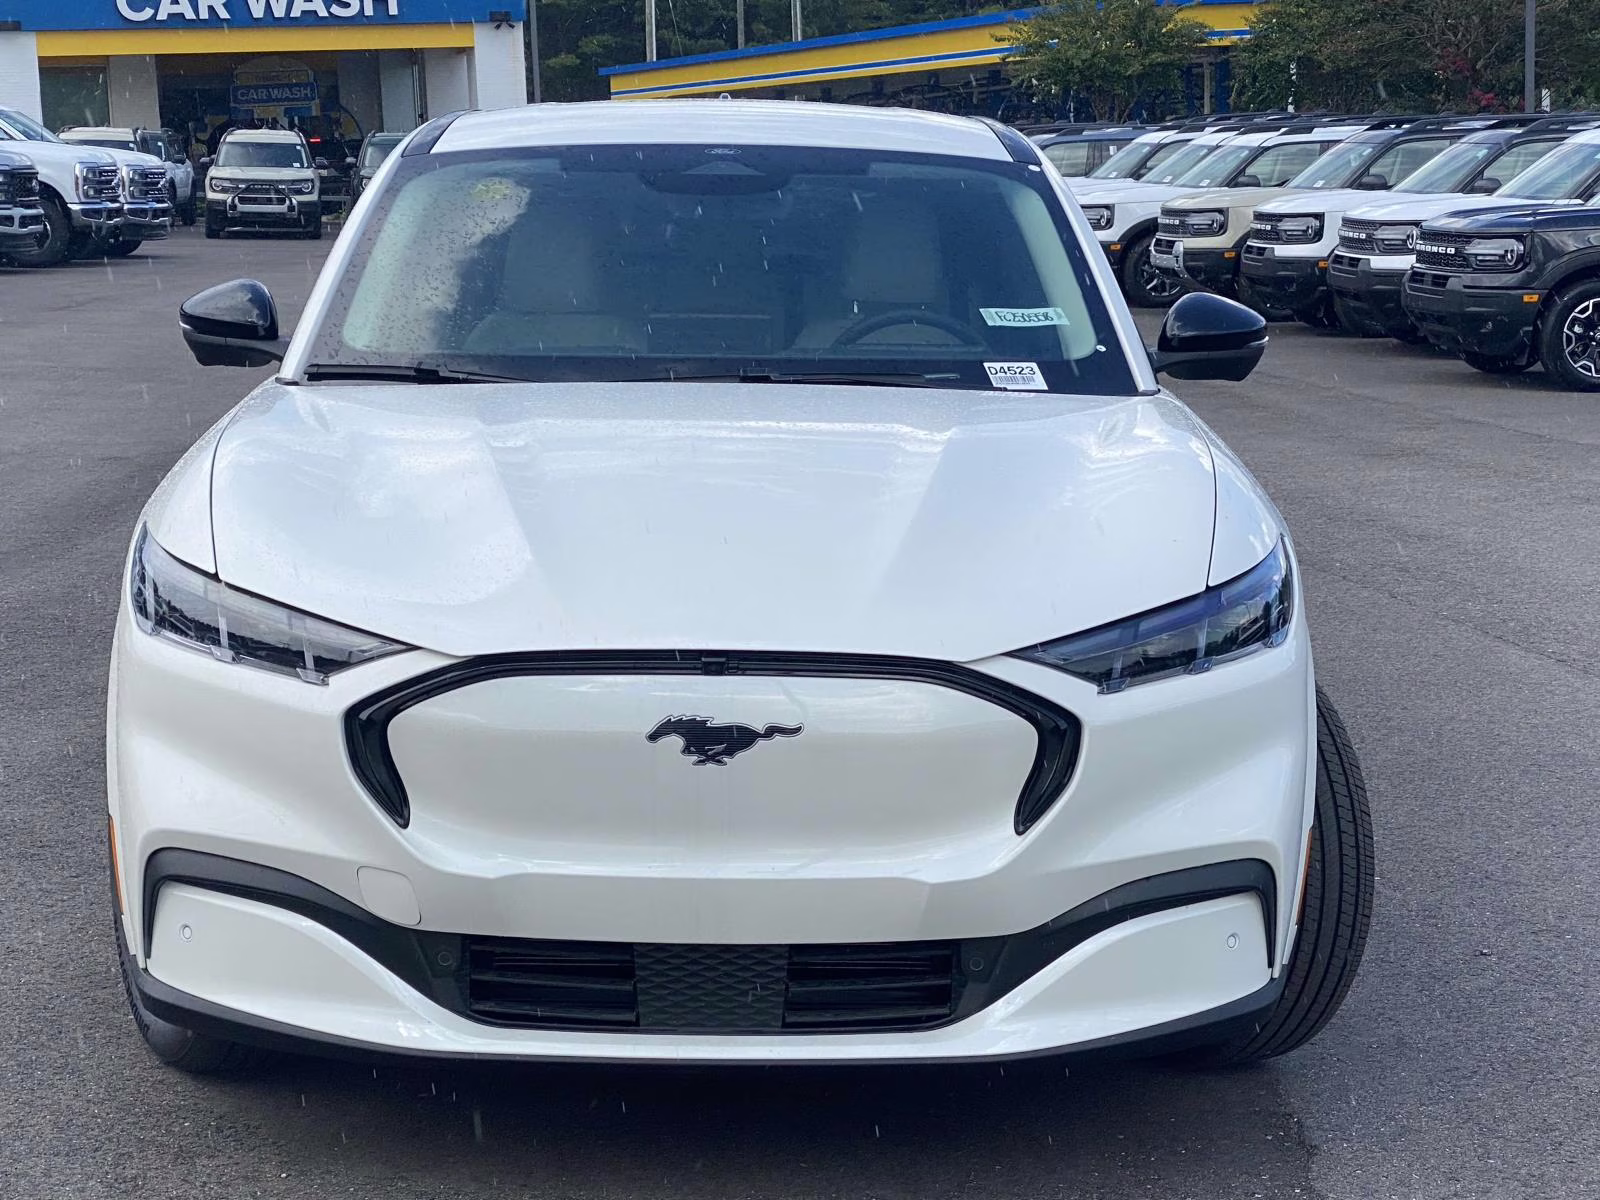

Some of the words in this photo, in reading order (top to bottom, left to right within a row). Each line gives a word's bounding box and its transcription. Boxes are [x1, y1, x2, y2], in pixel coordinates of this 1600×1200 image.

[238, 88, 267, 100] CAR
[269, 86, 311, 99] WASH
[1416, 243, 1455, 255] BRONCO
[987, 366, 1036, 376] D4523
